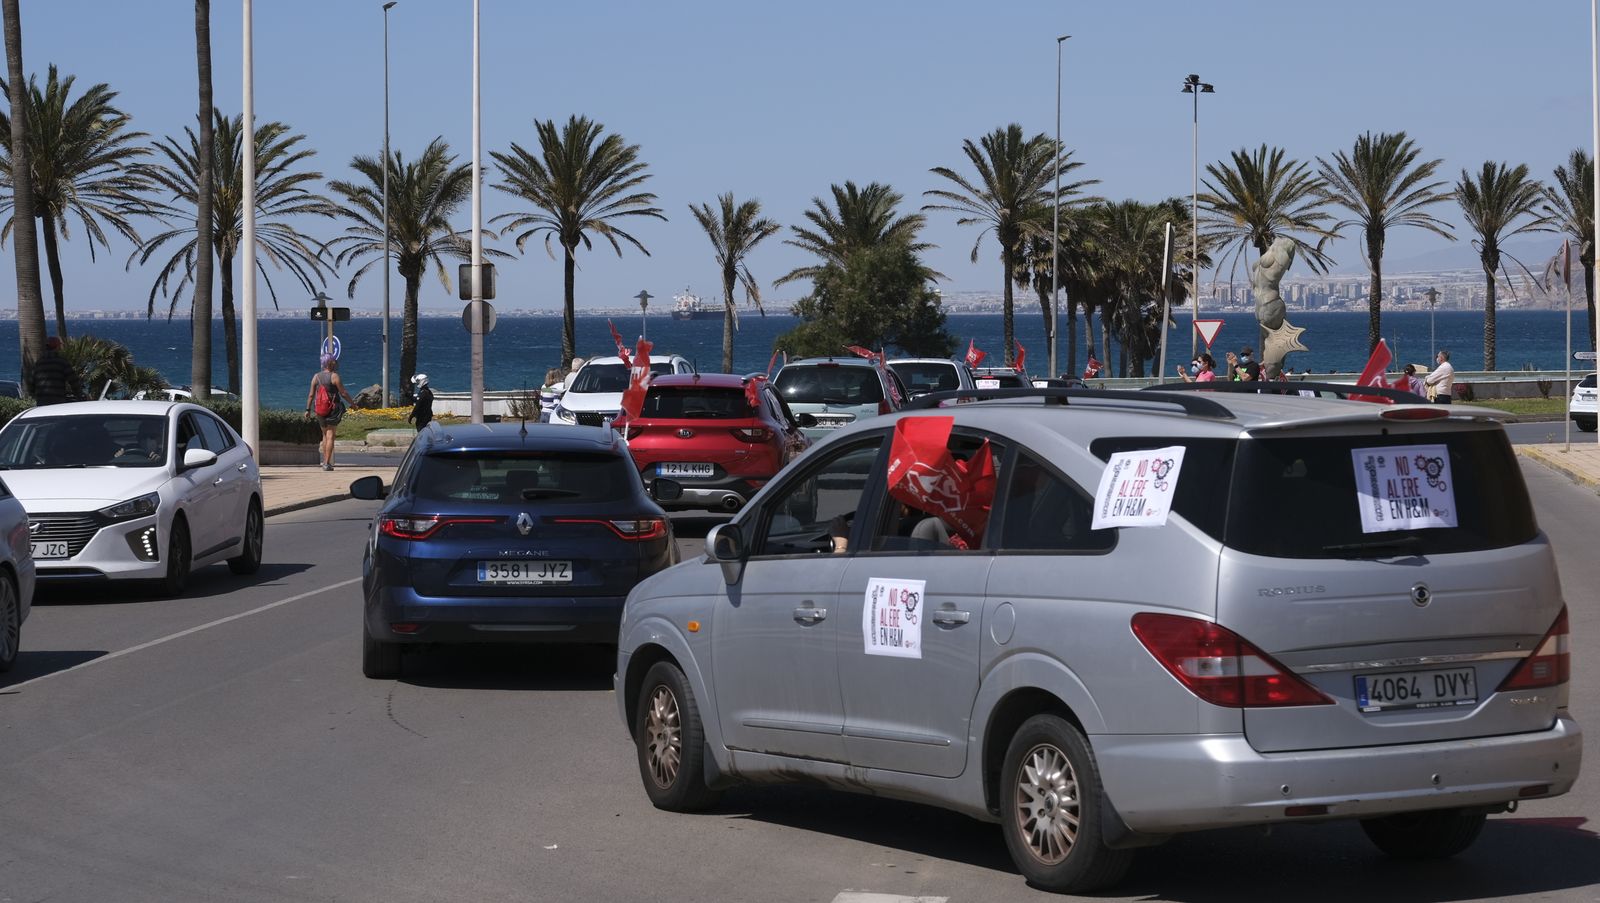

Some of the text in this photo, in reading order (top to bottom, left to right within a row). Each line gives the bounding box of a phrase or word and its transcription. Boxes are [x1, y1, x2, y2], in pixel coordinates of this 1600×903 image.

[666, 463, 711, 473] 1214 KHG
[1135, 460, 1149, 477] NO
[1395, 456, 1410, 476] NO
[1118, 480, 1149, 497] AL ERE
[1387, 478, 1421, 498] AL ERE
[1112, 498, 1125, 517] EN
[1123, 498, 1147, 517] H&M
[1389, 500, 1404, 519] EN
[1404, 498, 1431, 519] H&M
[42, 544, 66, 556] JZC
[490, 563, 569, 578] 3581 JYZ
[888, 588, 898, 607] NO
[1257, 585, 1326, 597] RODIUS
[880, 608, 901, 628] AL ERE
[880, 627, 888, 646] EN
[889, 628, 903, 647] H&M
[1371, 673, 1469, 702] 4064 DVY
